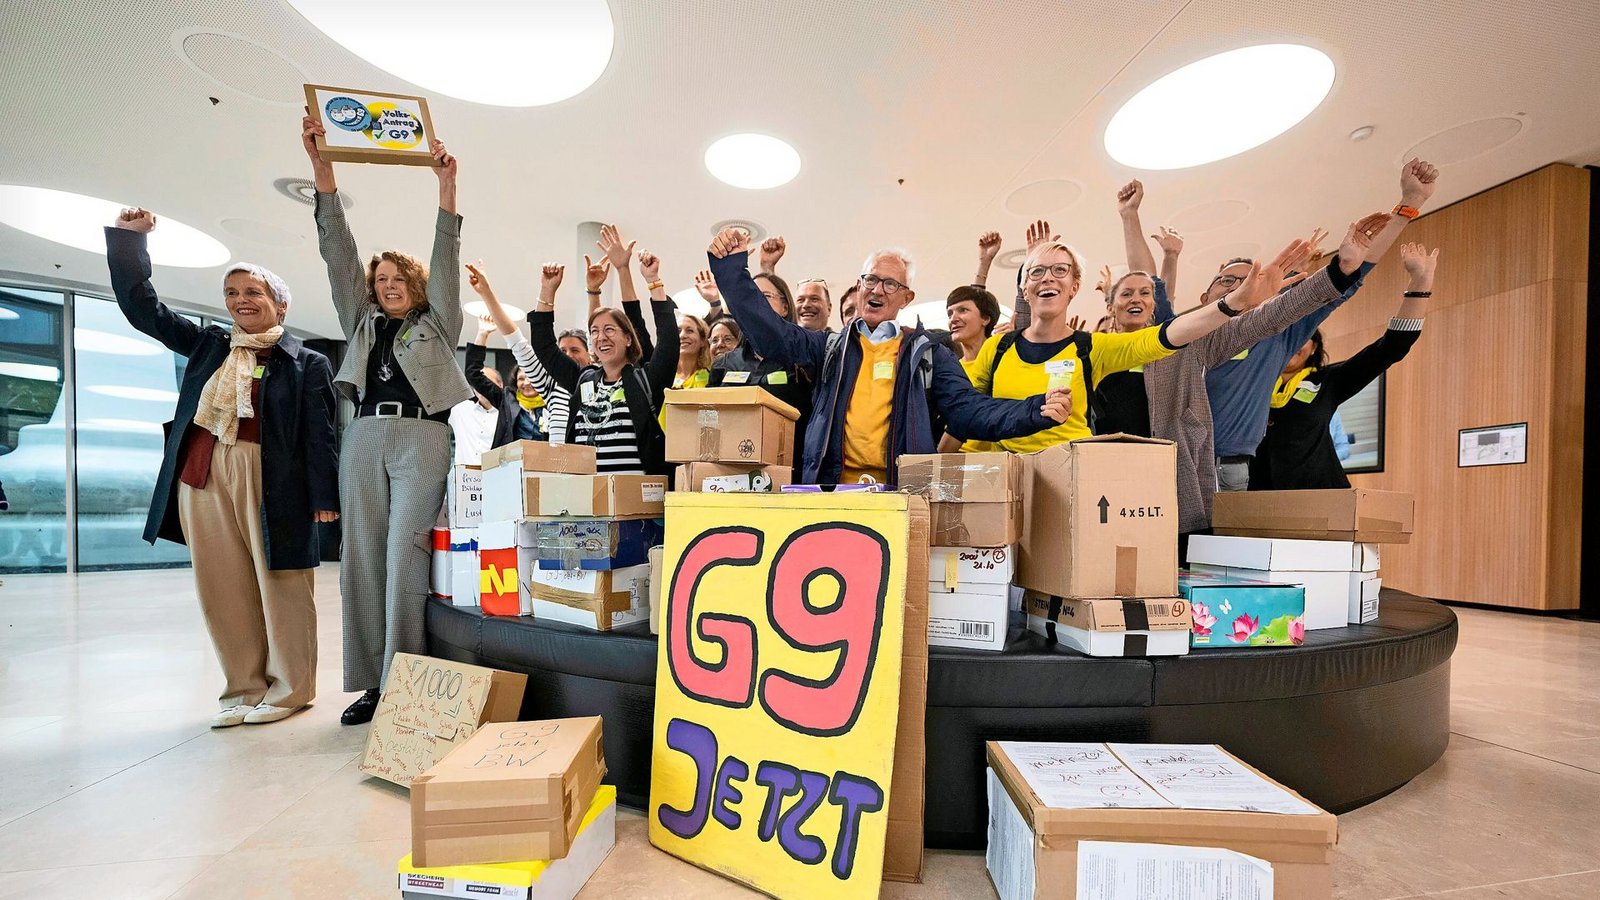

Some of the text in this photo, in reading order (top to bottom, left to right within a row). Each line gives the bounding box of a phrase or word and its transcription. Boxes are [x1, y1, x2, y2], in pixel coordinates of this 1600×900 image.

[383, 118, 415, 129] Antrag
[388, 129, 410, 140] G9
[1119, 506, 1164, 518] 4 x 5 LT.
[667, 521, 890, 737] G9
[413, 664, 464, 701] 1000
[658, 718, 884, 880] JETZT
